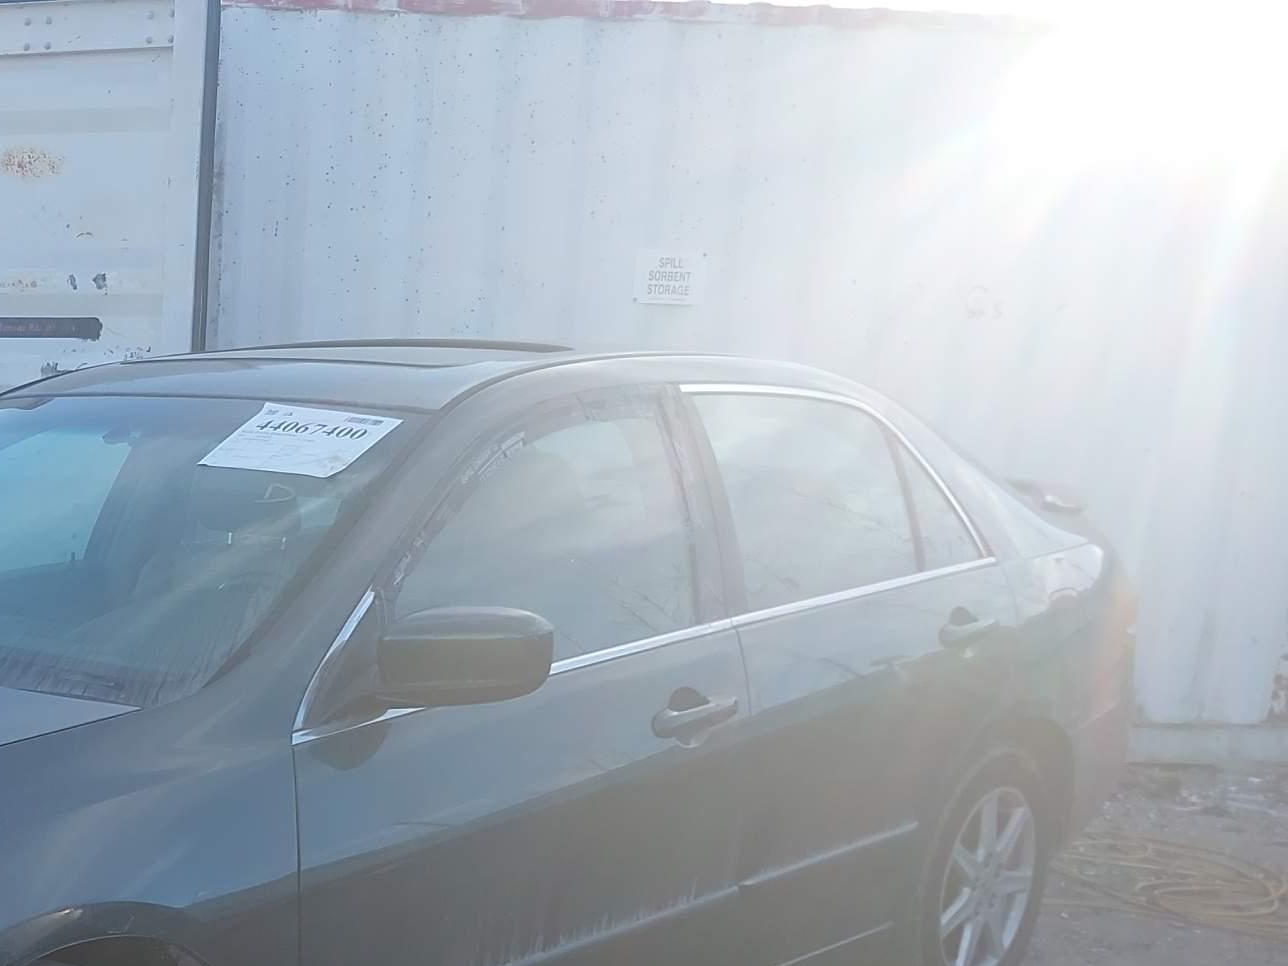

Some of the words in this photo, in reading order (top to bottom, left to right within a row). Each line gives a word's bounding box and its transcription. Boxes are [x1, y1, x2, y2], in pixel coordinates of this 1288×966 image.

[658, 257, 684, 269] SPILL
[648, 270, 692, 282] SORBENT
[647, 284, 691, 296] STORAGE
[256, 419, 368, 440] 44067400
